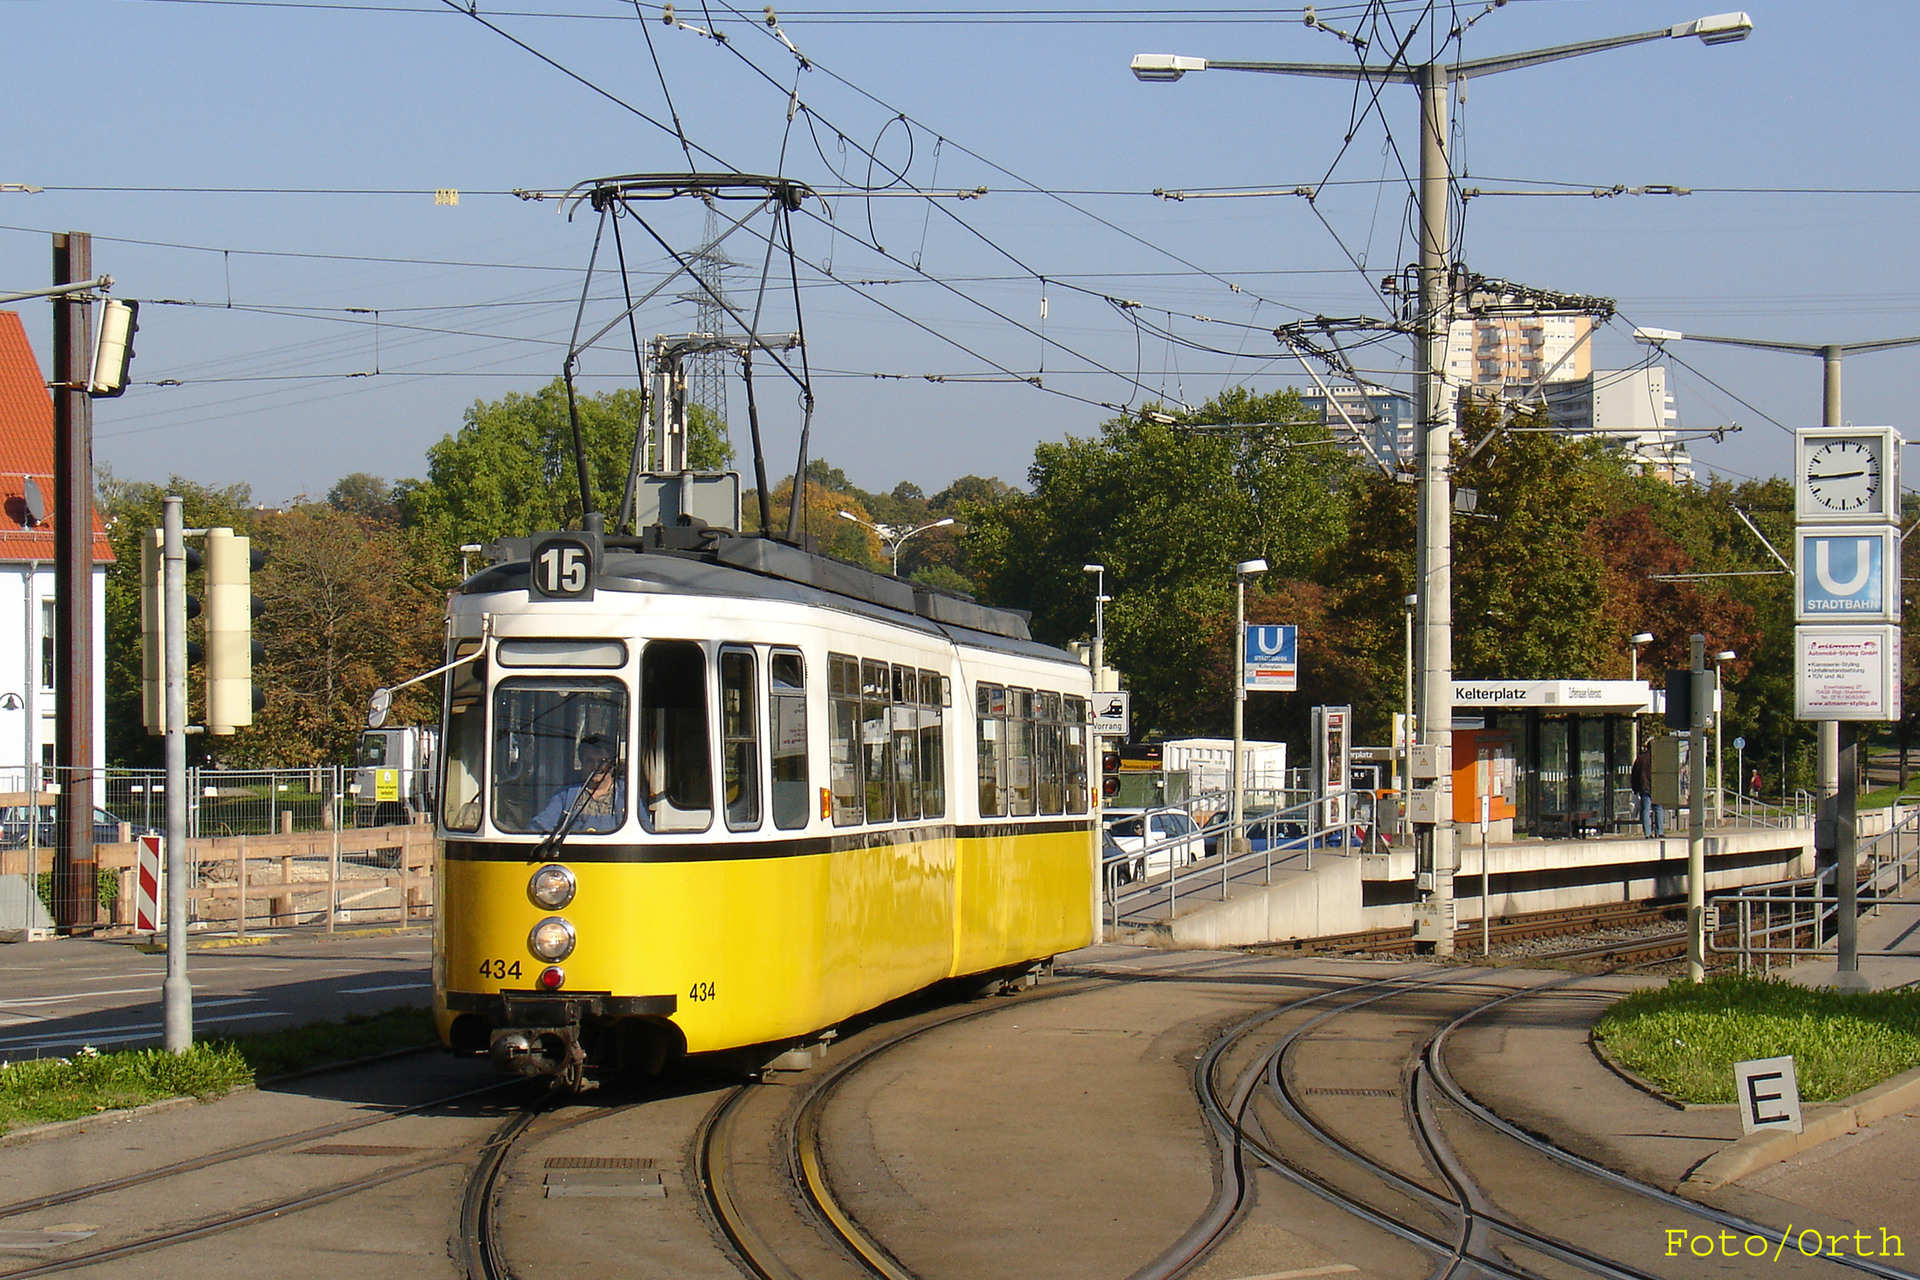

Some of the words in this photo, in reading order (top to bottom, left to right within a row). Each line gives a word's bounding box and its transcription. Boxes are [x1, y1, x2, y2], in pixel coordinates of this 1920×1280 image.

[540, 548, 586, 592] 15
[1816, 540, 1870, 596] U
[1807, 599, 1881, 610] STADTBAHN
[1258, 627, 1284, 655] U
[1455, 687, 1527, 702] Kelterplatz
[1093, 722, 1122, 731] Vorrang
[1704, 911, 1716, 927] E
[479, 959, 522, 980] 434
[689, 981, 716, 1002] 434
[1746, 1071, 1790, 1125] E
